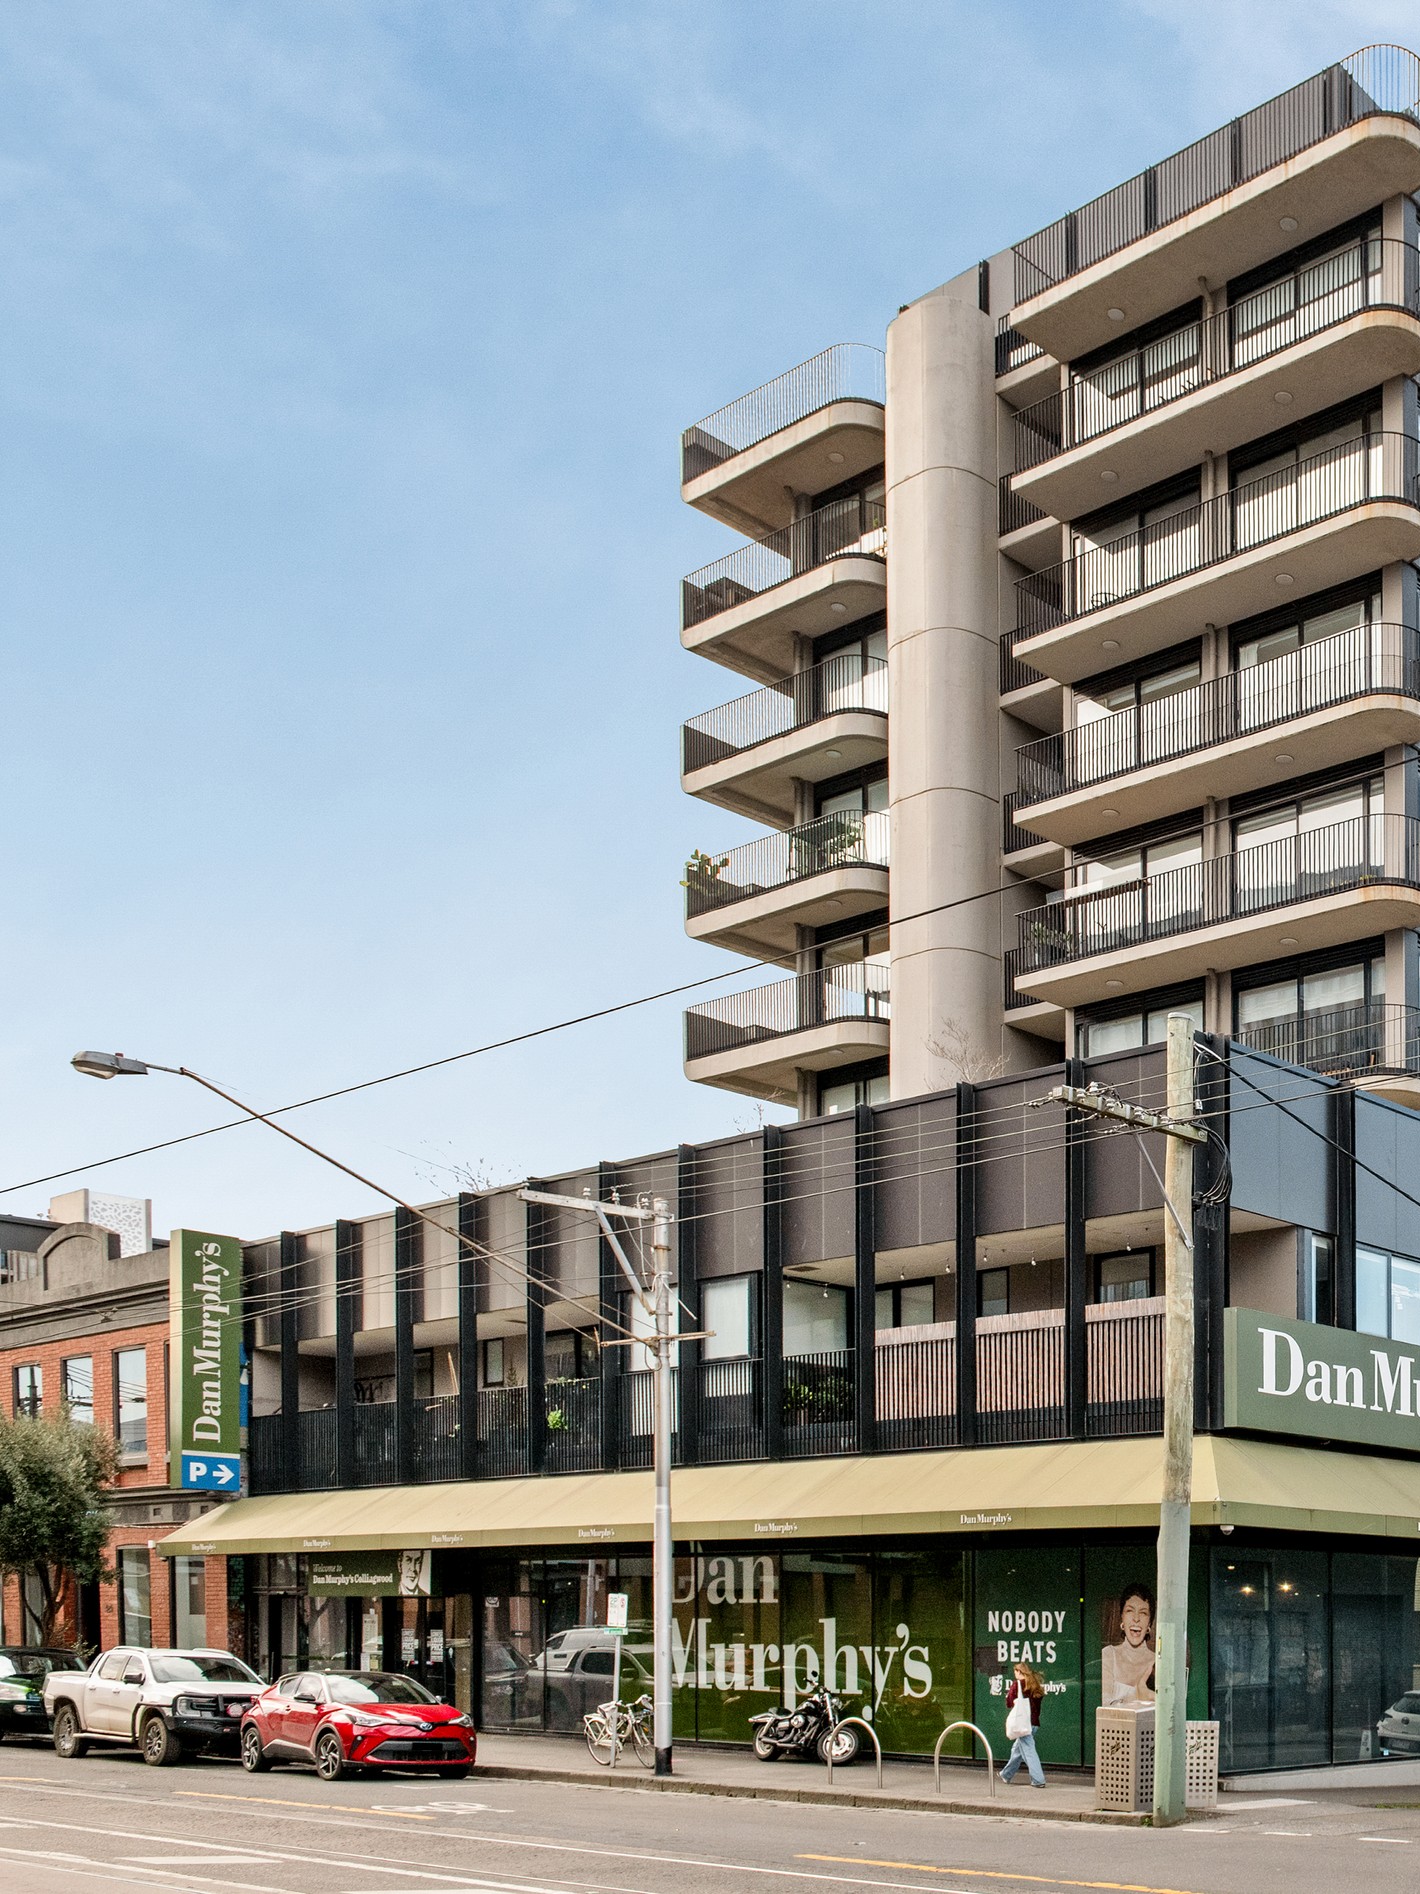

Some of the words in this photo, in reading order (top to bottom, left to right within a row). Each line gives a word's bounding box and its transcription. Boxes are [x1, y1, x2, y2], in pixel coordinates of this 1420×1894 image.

[193, 1242, 230, 1379] Murphy's
[1257, 1327, 1366, 1409] Dan
[192, 1380, 221, 1443] Dan
[189, 1462, 208, 1482] P
[754, 1523, 768, 1532] Dan
[768, 1522, 798, 1534] Murphy's
[960, 1514, 977, 1524] Dan
[977, 1513, 1012, 1526] Murphy's
[578, 1529, 590, 1538] Dan
[590, 1528, 615, 1539] Murphy's
[312, 1575, 325, 1584] Dan
[325, 1575, 354, 1585] Murphy's
[987, 1610, 1066, 1633] NOBODY
[997, 1640, 1057, 1664] BEATS
[672, 1617, 932, 1721] Murphy's
[1040, 1681, 1067, 1695] phy's
